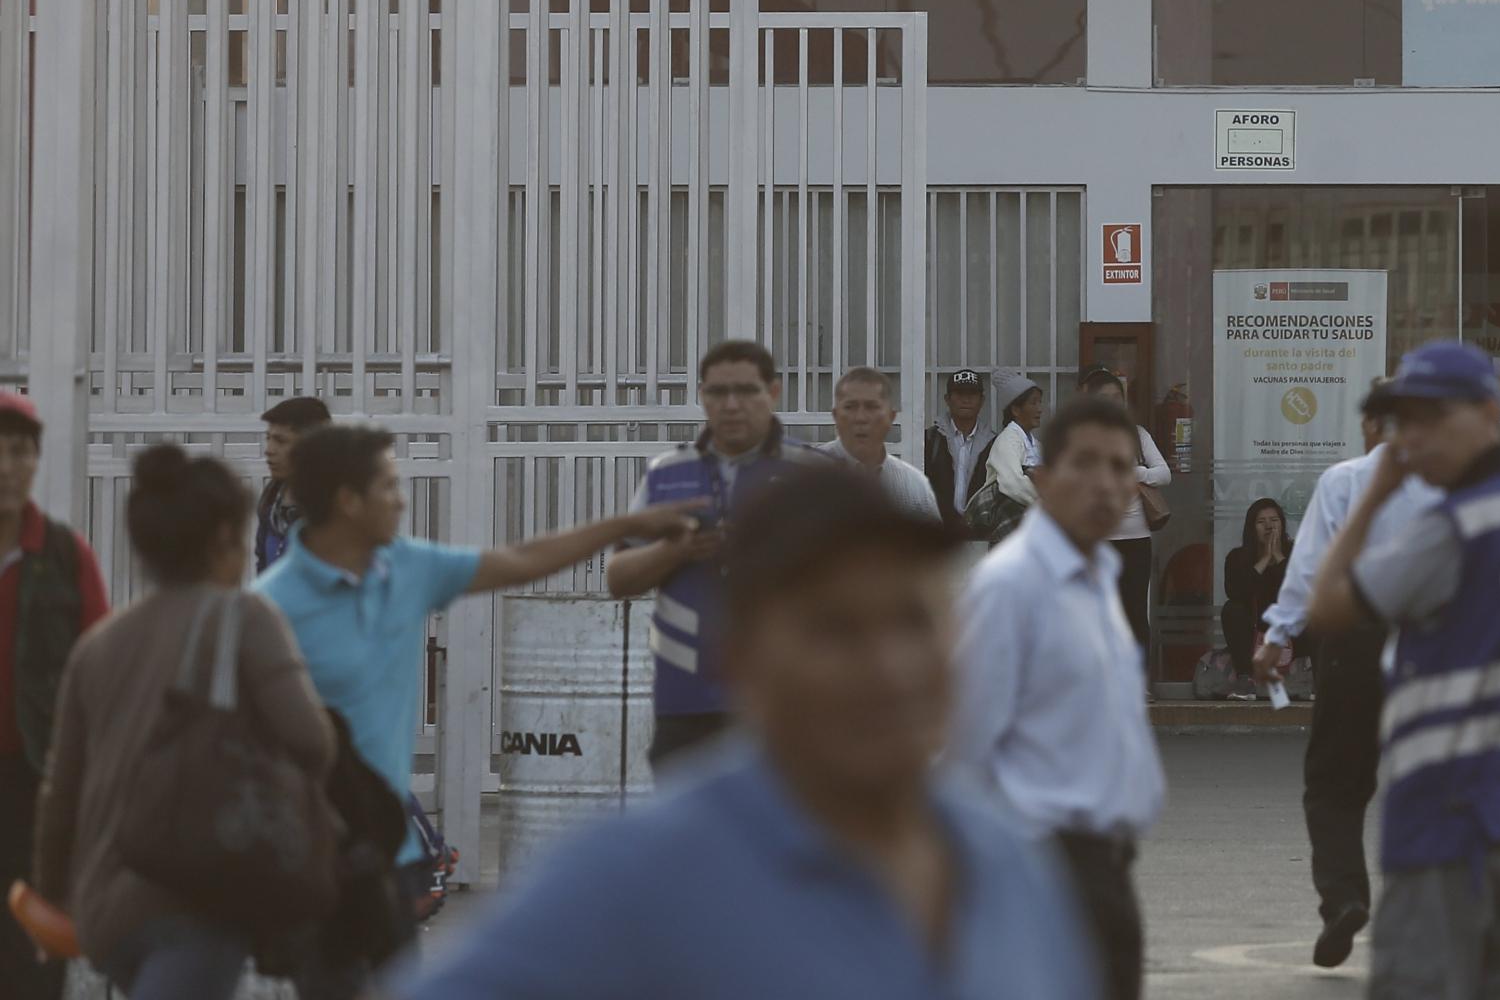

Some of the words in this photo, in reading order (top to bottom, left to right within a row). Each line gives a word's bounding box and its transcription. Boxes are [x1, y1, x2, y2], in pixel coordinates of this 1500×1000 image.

[1232, 115, 1281, 125] AFORO
[1221, 157, 1290, 166] PERSONAS
[1105, 270, 1139, 279] EXTINTOR
[1227, 315, 1374, 327] RECOMENDACIONES
[1227, 329, 1259, 340] PARA
[1262, 329, 1310, 340] CUIDAR
[1311, 329, 1328, 340] TU
[1331, 329, 1374, 340] SALUD
[1243, 347, 1288, 358] durante
[1292, 347, 1302, 358] la
[1305, 347, 1335, 358] visita
[1338, 347, 1356, 358] del
[1265, 361, 1297, 371] santo
[1300, 360, 1334, 373] padre
[504, 731, 582, 756] CANIA
